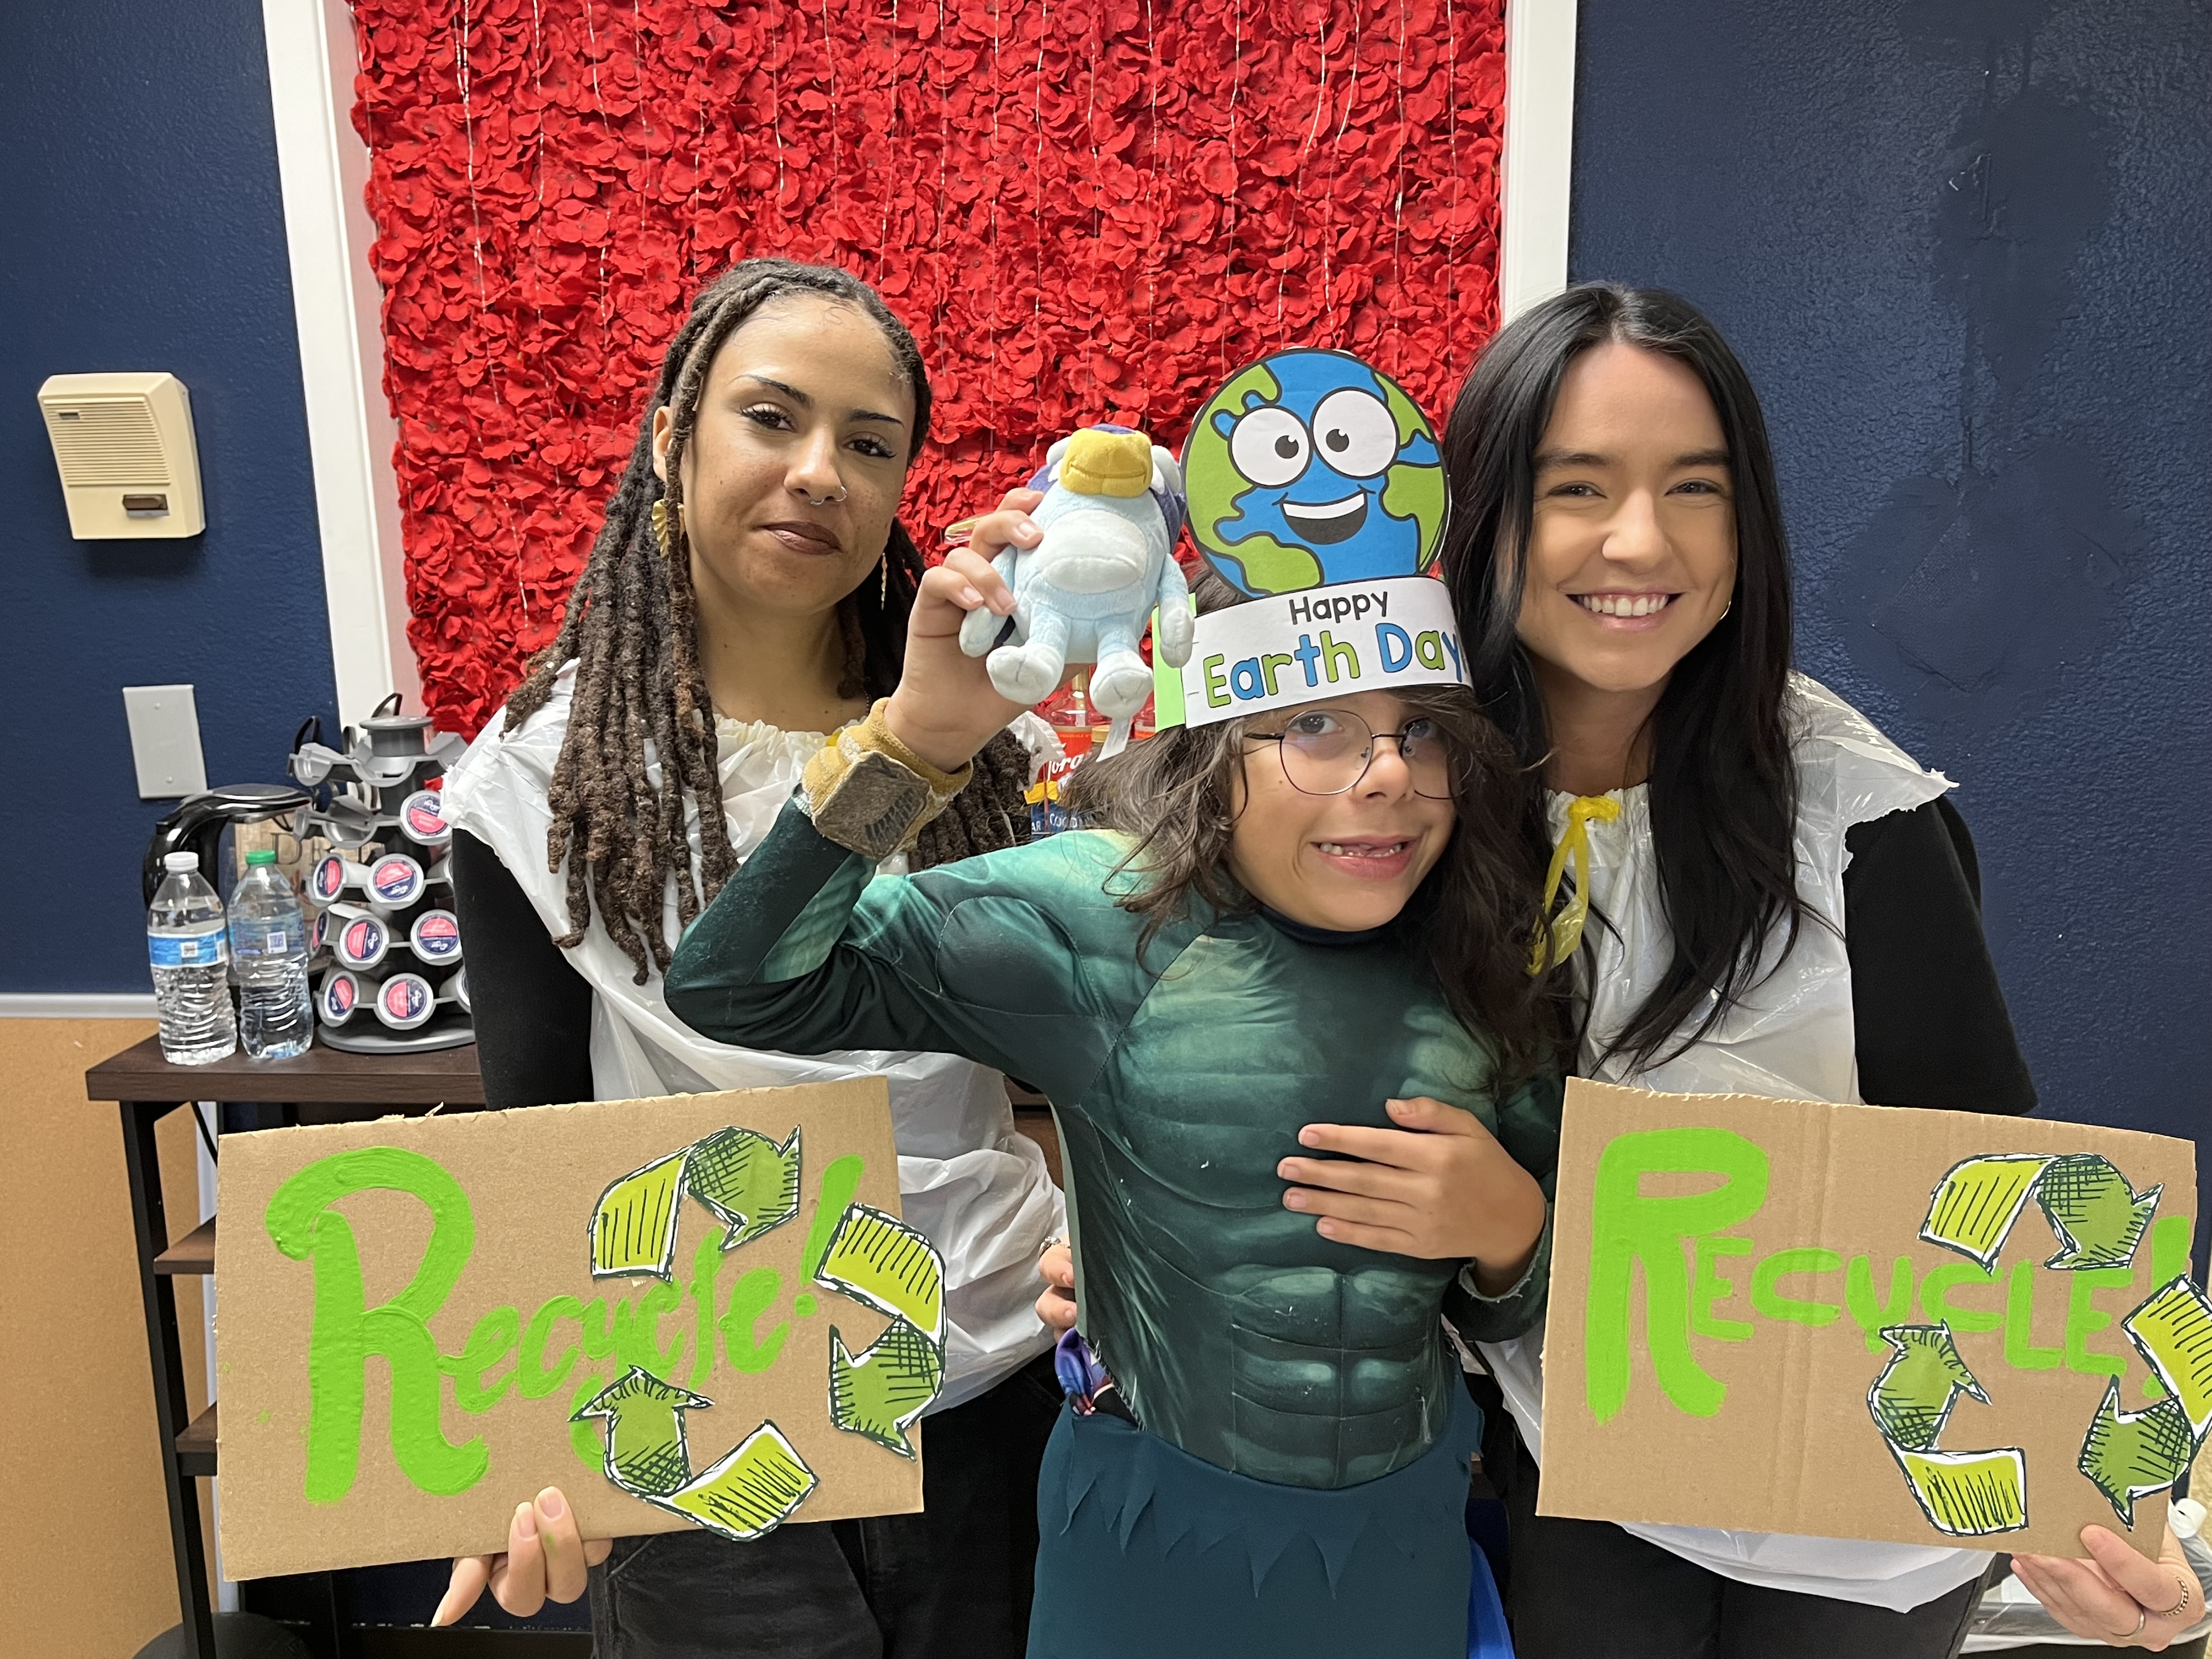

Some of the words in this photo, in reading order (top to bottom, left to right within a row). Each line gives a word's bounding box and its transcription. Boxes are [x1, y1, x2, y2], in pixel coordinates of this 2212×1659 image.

[1289, 591, 1388, 625] Happy
[1203, 630, 1361, 708] Earth
[1375, 623, 1463, 683] Day
[265, 1146, 865, 1504] Recycle!
